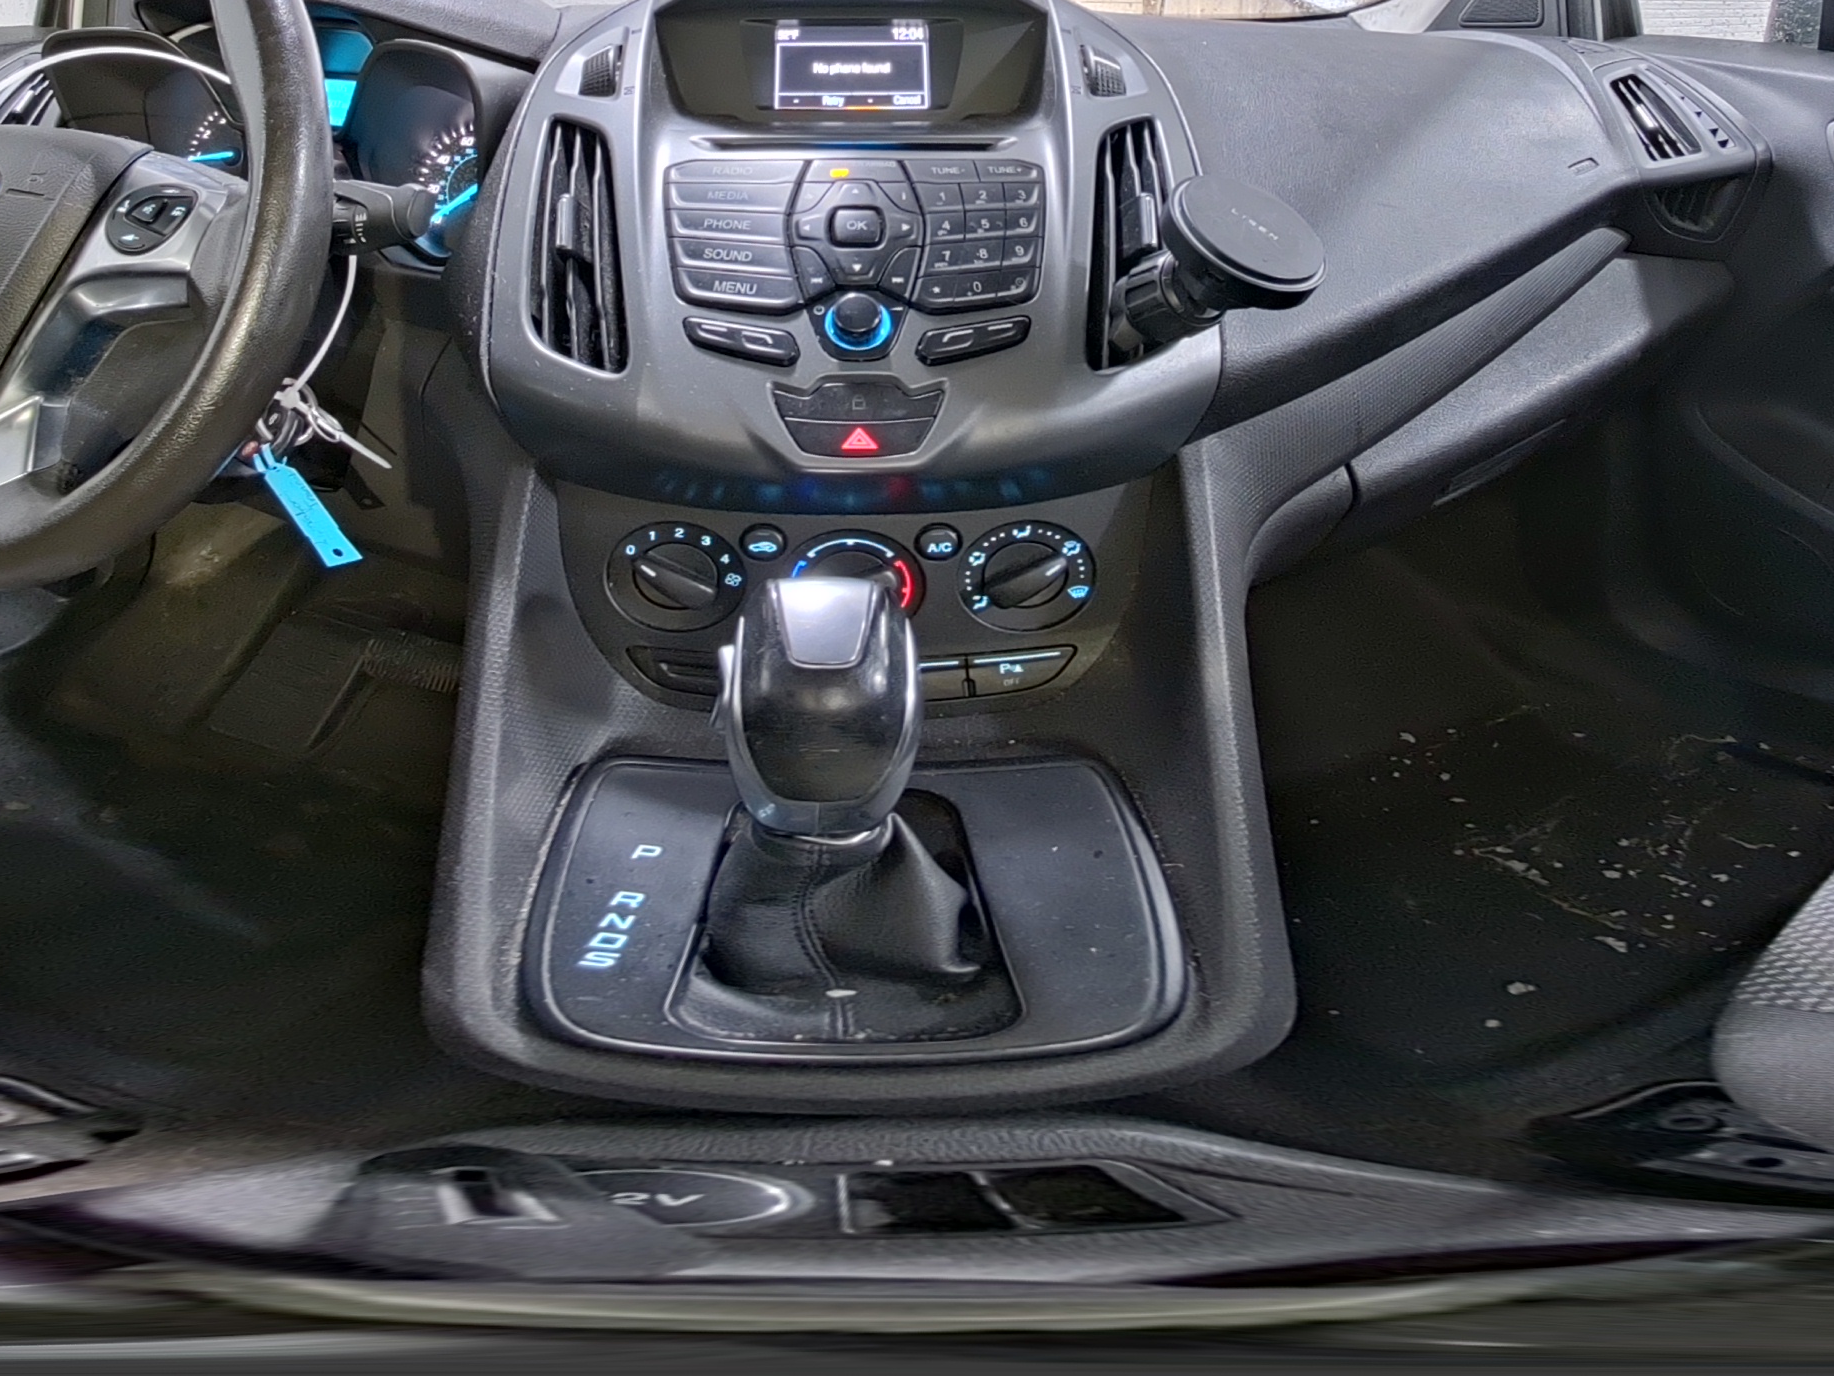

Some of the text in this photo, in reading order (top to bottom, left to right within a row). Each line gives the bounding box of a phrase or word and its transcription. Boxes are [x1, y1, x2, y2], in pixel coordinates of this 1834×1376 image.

[891, 27, 925, 40] 12:04
[812, 62, 891, 75] No phone found
[822, 95, 921, 107] Retry Cancel
[460, 136, 474, 146] 60
[437, 155, 450, 164] 40
[712, 167, 753, 176] RADIO
[428, 184, 440, 193] 20
[707, 190, 749, 200] MEDIA
[939, 192, 946, 201] 1
[978, 190, 987, 199] 2
[1017, 190, 1026, 200] 3
[704, 218, 752, 230] PHONE
[846, 220, 867, 231] OK
[942, 220, 950, 230] 4
[981, 218, 989, 229] 5
[1019, 217, 1028, 227] 6
[703, 248, 752, 262] SOUND
[942, 251, 951, 261] 7
[979, 248, 988, 259] 8
[1015, 246, 1025, 256] 9
[713, 280, 757, 294] MENU
[973, 281, 982, 292] 0
[649, 531, 656, 541] 1
[674, 528, 685, 538] 2
[701, 536, 711, 546] 3
[625, 545, 636, 555] 0
[927, 542, 952, 552] A/C
[720, 554, 730, 564] 4
[631, 844, 663, 859] P
[609, 891, 645, 908] R
[599, 912, 636, 929] N
[588, 932, 628, 949] D
[577, 951, 621, 967] S
[609, 1192, 705, 1207] 2V
